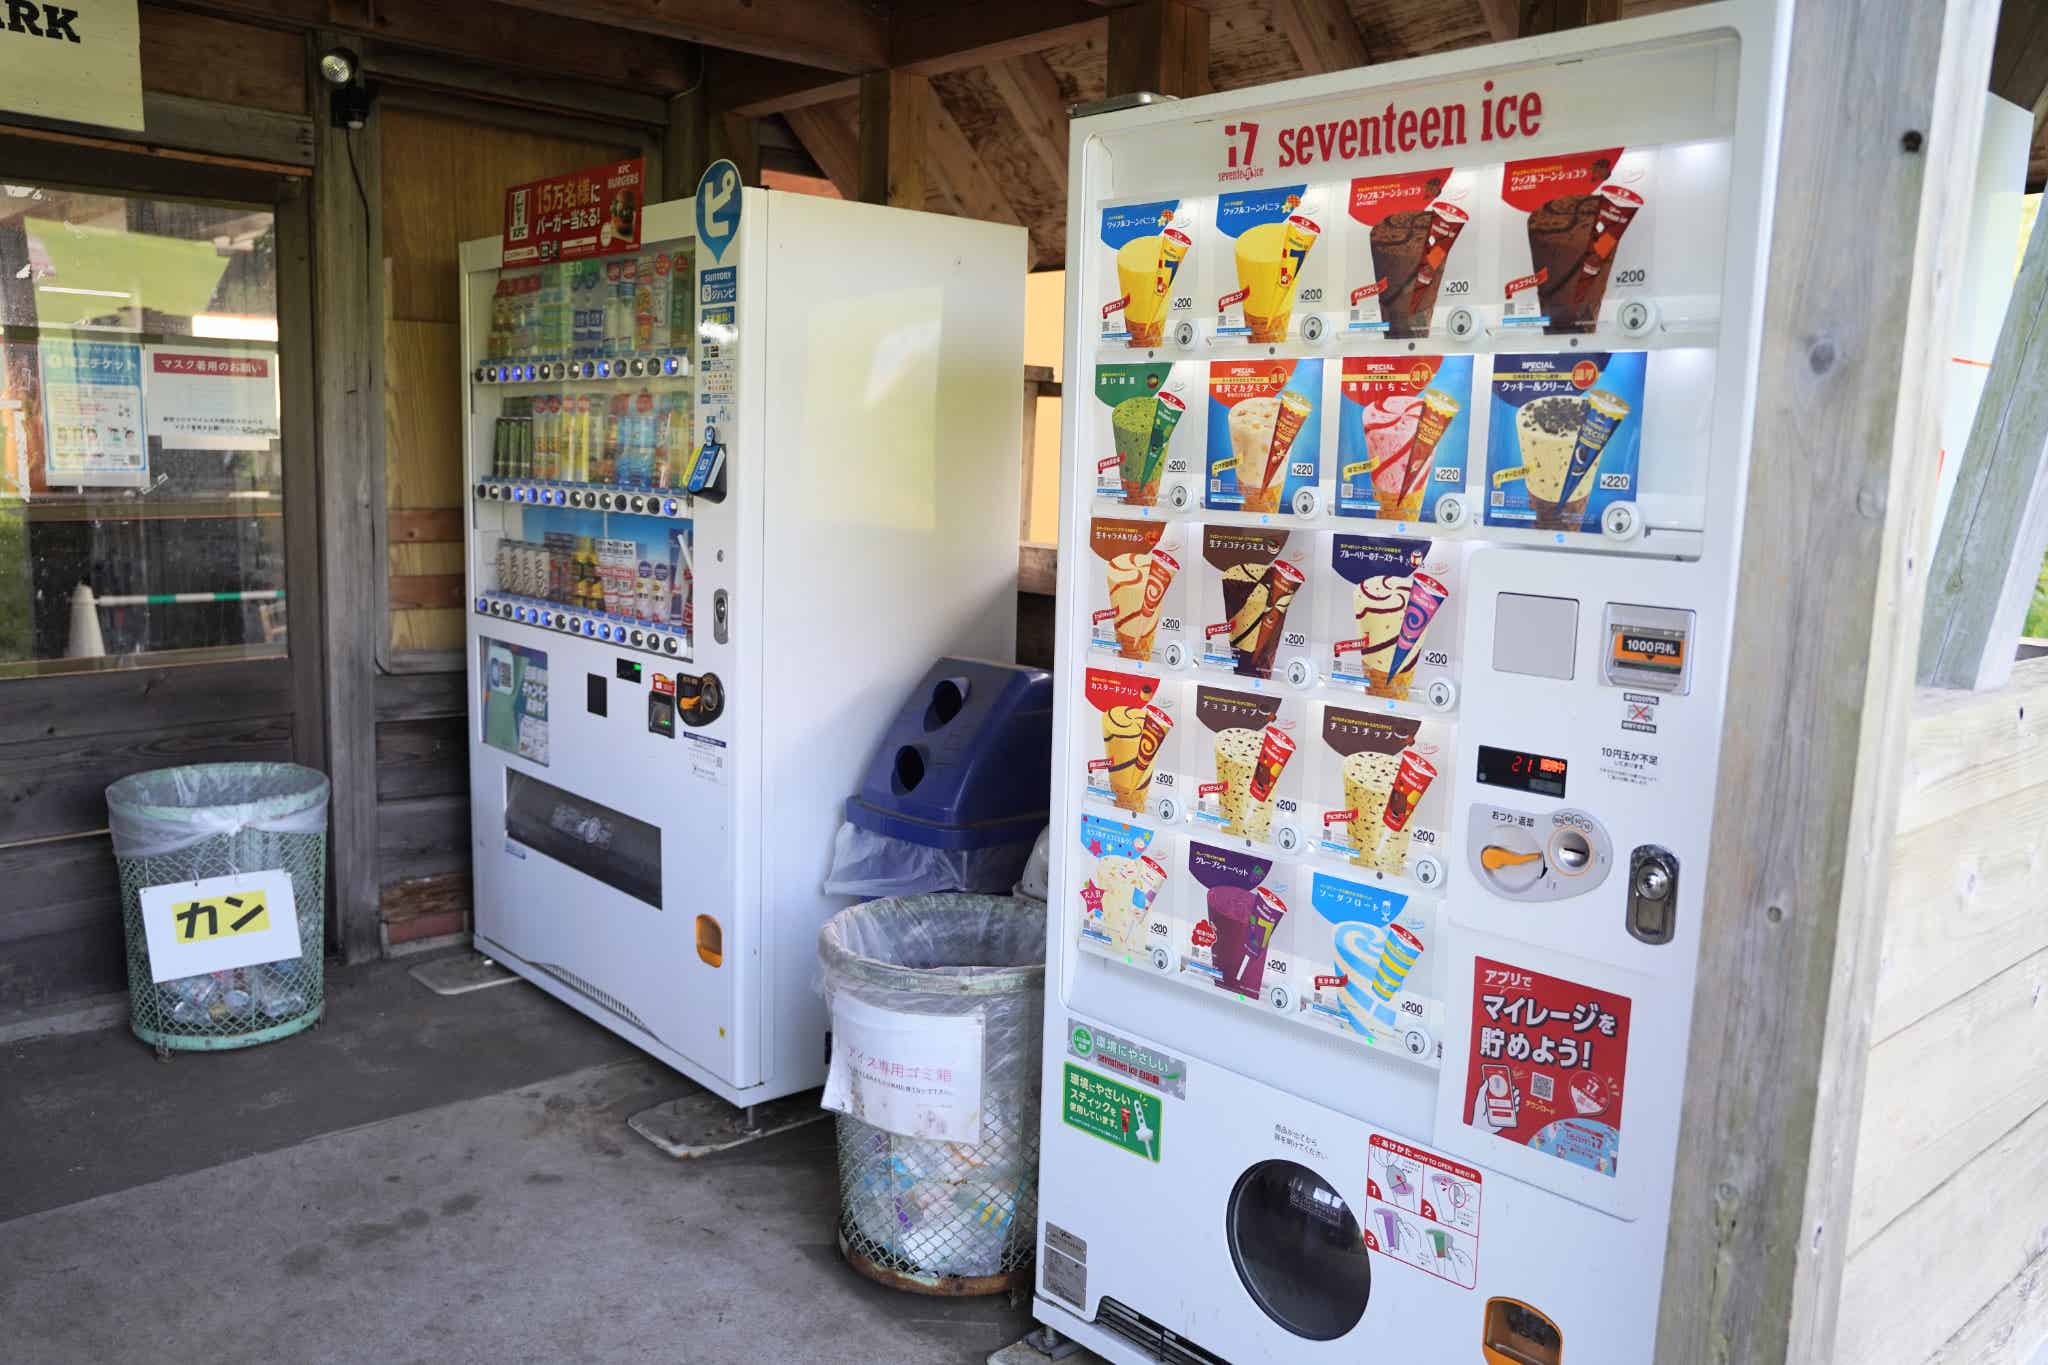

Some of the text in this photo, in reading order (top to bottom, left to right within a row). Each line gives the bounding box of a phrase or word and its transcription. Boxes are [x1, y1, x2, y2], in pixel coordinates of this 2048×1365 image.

[0, 0, 81, 43] RK
[1277, 80, 1543, 169] seventeen ice
[704, 271, 732, 282] SUNTORY
[160, 359, 262, 374] マスク着用のお願い
[1501, 382, 1574, 392] クッキー&クリーム
[1626, 638, 1676, 655] 1000円札
[1202, 701, 1257, 717] チョコチップ
[1329, 721, 1393, 740] チョコチップ
[1601, 746, 1658, 766] 10円玉が不足
[1491, 811, 1535, 828] おつり・返却
[1319, 887, 1379, 912] ソーダフロート
[176, 896, 265, 939] カン
[1484, 969, 1533, 988] アプリで
[1482, 994, 1618, 1037] マイレージを
[1095, 1034, 1170, 1073] 環境にやさしい
[1479, 1026, 1593, 1069] 貯めよう!
[849, 1046, 954, 1083] アイス専用ゴミ箱
[1069, 1071, 1131, 1106] 環境にやさしい
[1070, 1088, 1118, 1117] スティックを
[1069, 1102, 1120, 1130] 使用しています。
[1371, 1186, 1377, 1196] 1
[1424, 1206, 1432, 1217] 2
[1366, 1234, 1375, 1246] 3
